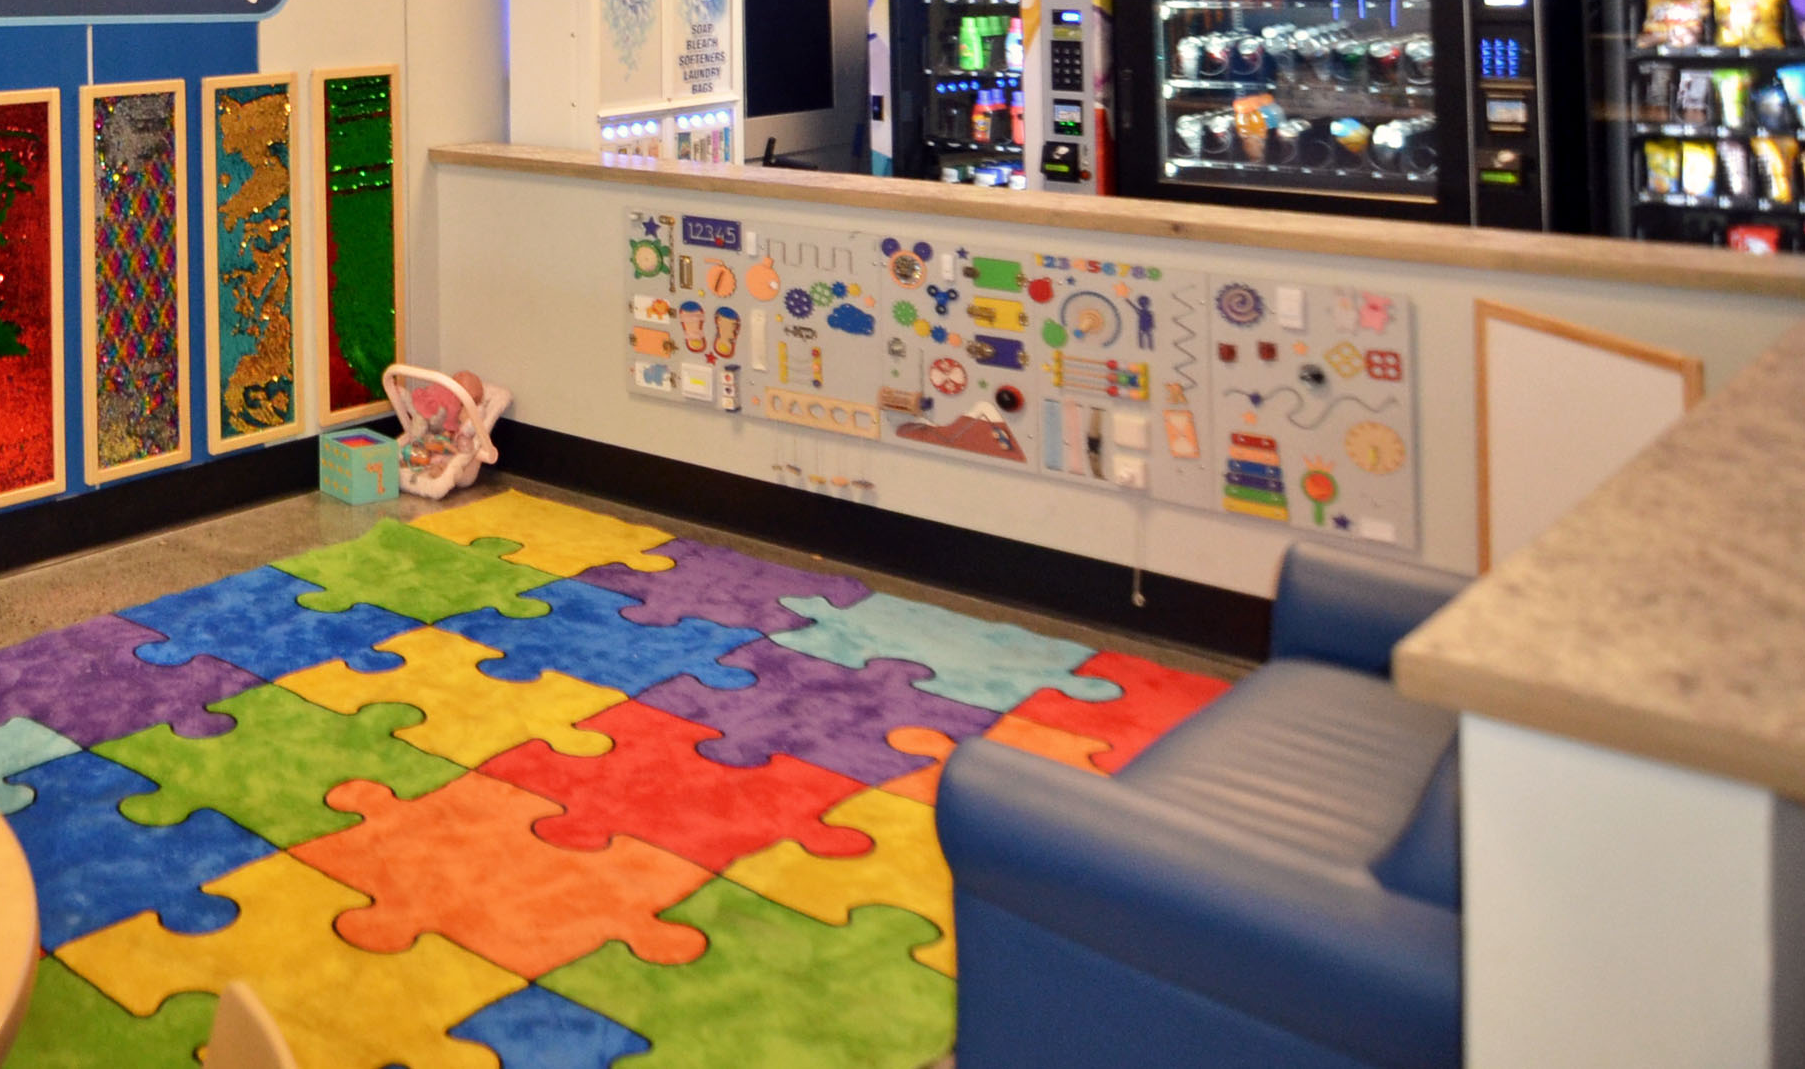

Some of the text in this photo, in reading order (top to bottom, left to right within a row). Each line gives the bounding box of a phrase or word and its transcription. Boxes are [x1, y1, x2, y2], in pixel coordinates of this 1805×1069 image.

[691, 24, 713, 35] SOAP
[686, 38, 718, 51] BLEACH
[679, 51, 726, 66] SOFTENERS
[683, 67, 721, 81] LAUNDRY
[691, 82, 713, 94] BAGS
[688, 222, 737, 244] 12345
